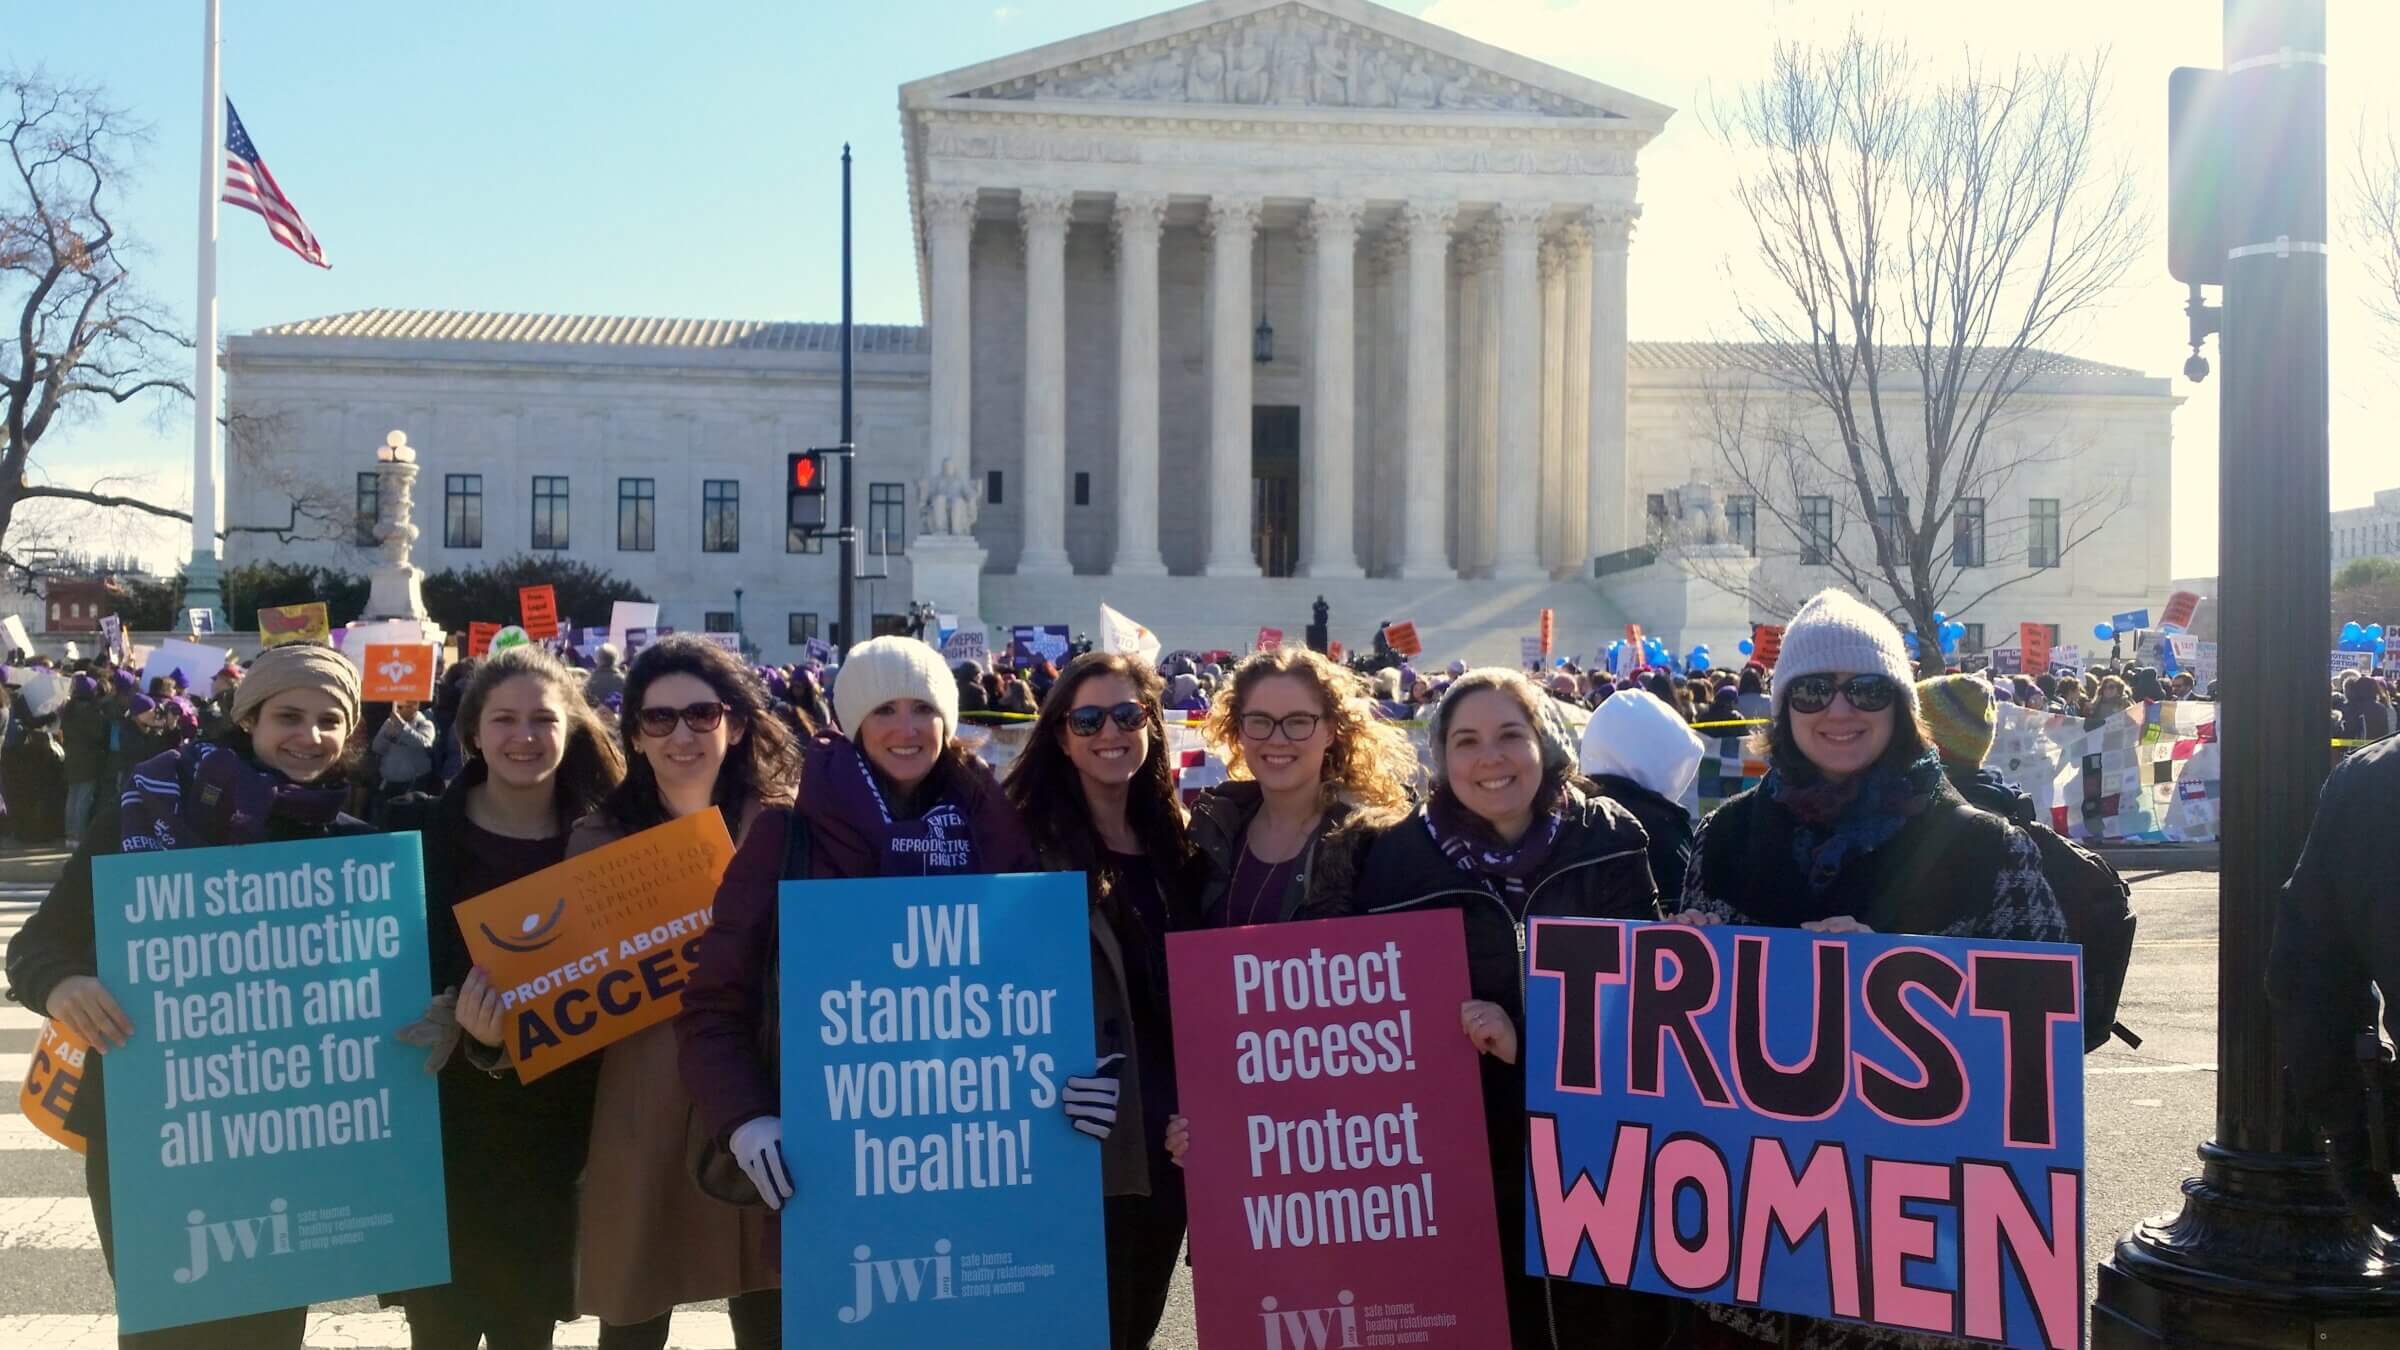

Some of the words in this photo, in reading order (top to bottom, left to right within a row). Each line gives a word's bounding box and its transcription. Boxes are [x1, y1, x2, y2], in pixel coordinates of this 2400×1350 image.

[124, 872, 195, 924] JWI
[204, 863, 334, 916] stands
[341, 859, 396, 904] for
[127, 911, 401, 988] reproductive
[892, 903, 981, 969] JWI
[153, 978, 293, 1042] health
[303, 968, 382, 1026] and
[501, 948, 611, 1010] PROTECT
[820, 975, 992, 1046] stands
[998, 983, 1057, 1037] for
[1232, 941, 1406, 1015] Protect
[164, 1040, 311, 1110] justice
[319, 1033, 381, 1085] for
[1235, 1009, 1416, 1085] access!
[1530, 918, 2080, 1149] TRUST
[824, 1044, 1057, 1121] women's
[160, 1109, 214, 1168] all
[221, 1087, 393, 1159] women!
[854, 1119, 1033, 1197] health!
[1247, 1103, 1424, 1178] Protect
[1243, 1173, 1438, 1250] women!
[1527, 1111, 2081, 1350] WOMEN
